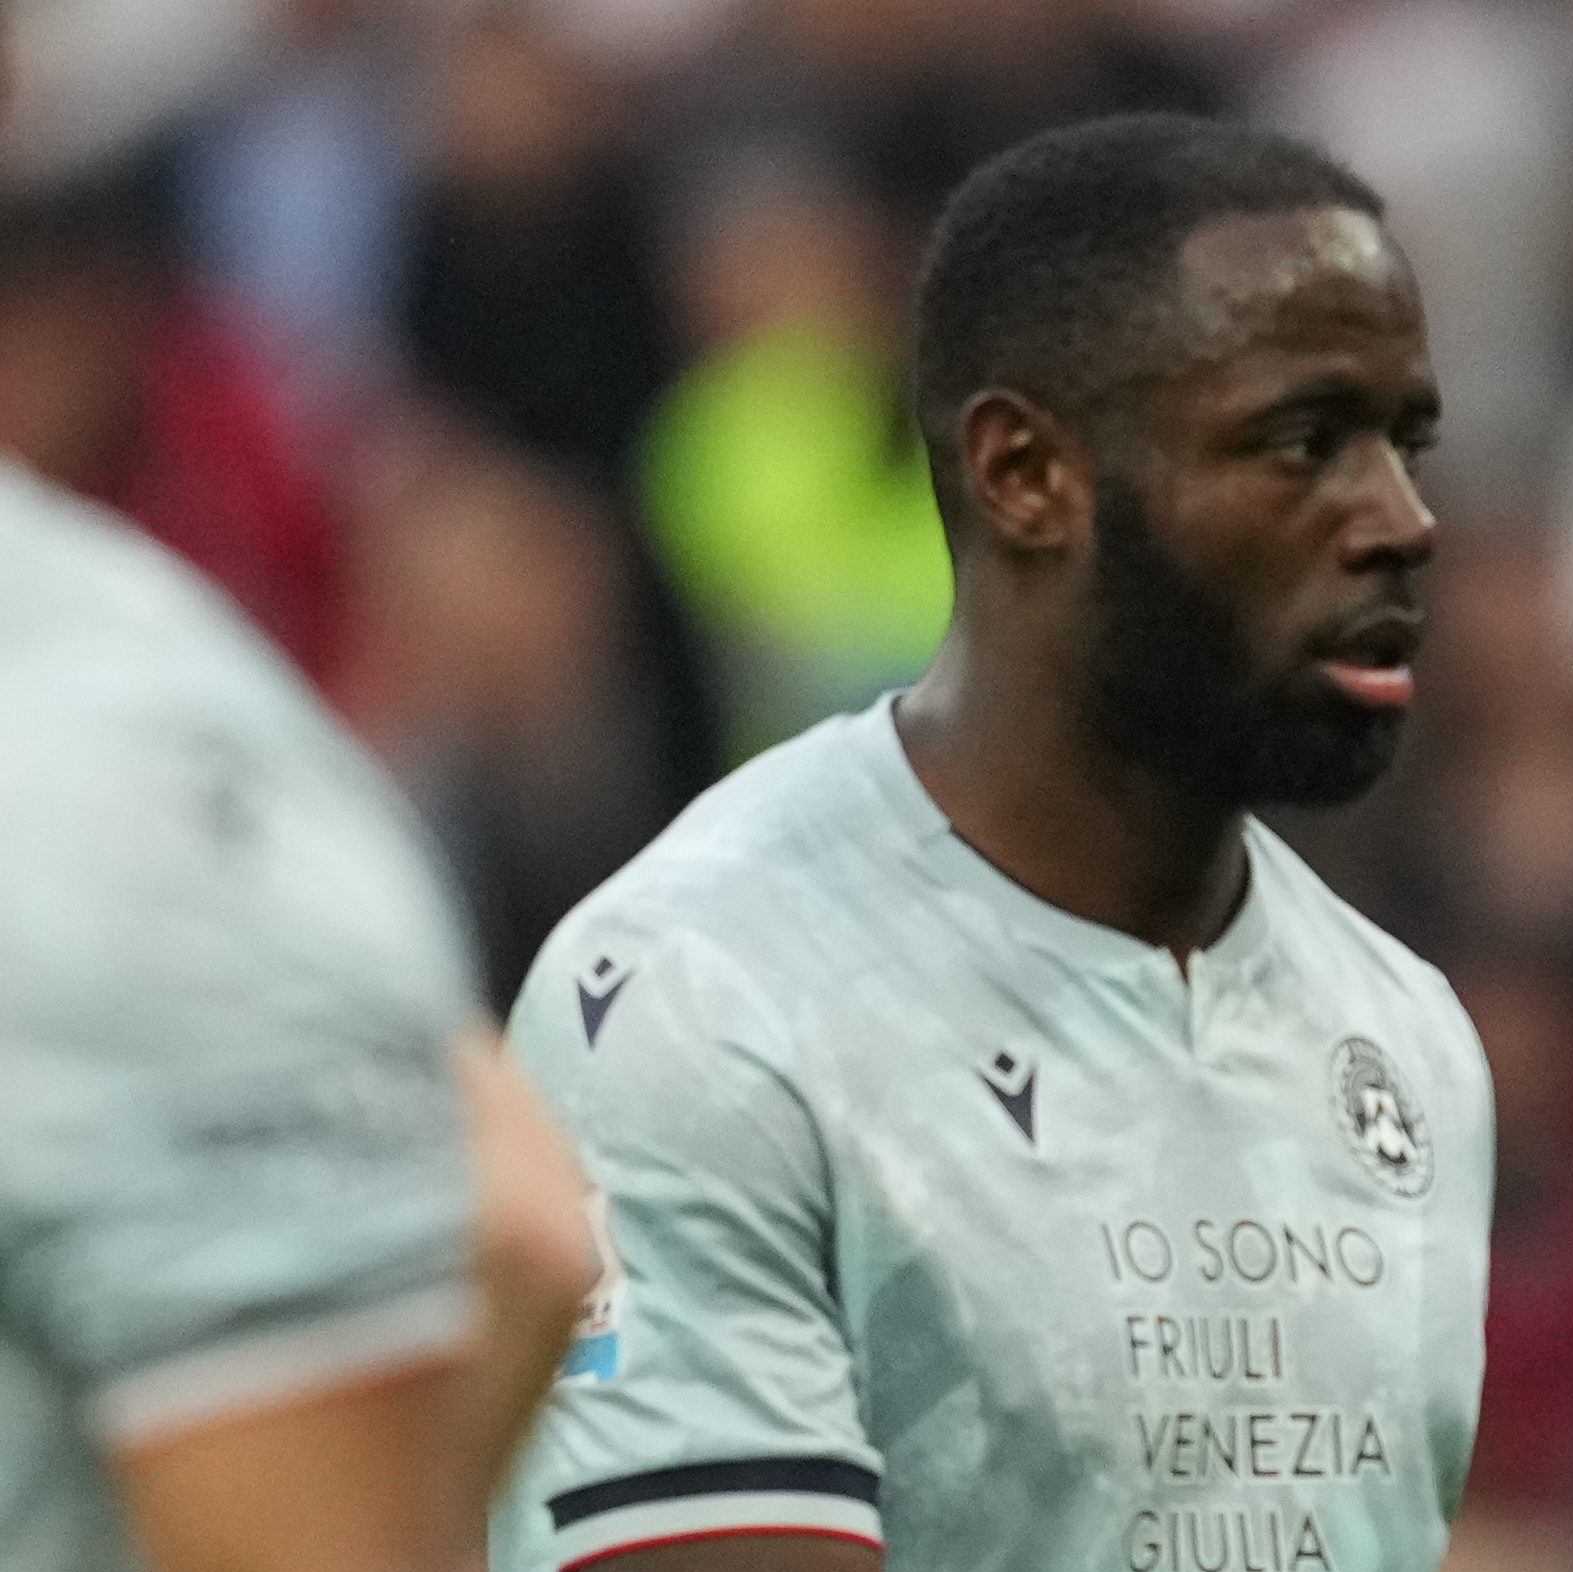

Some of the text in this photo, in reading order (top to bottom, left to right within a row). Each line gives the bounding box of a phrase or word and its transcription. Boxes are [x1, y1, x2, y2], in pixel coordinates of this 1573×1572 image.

[1102, 1219, 1384, 1286] IO SONO
[1126, 1316, 1283, 1379] FRIULI
[1137, 1414, 1391, 1478] VENEZIA
